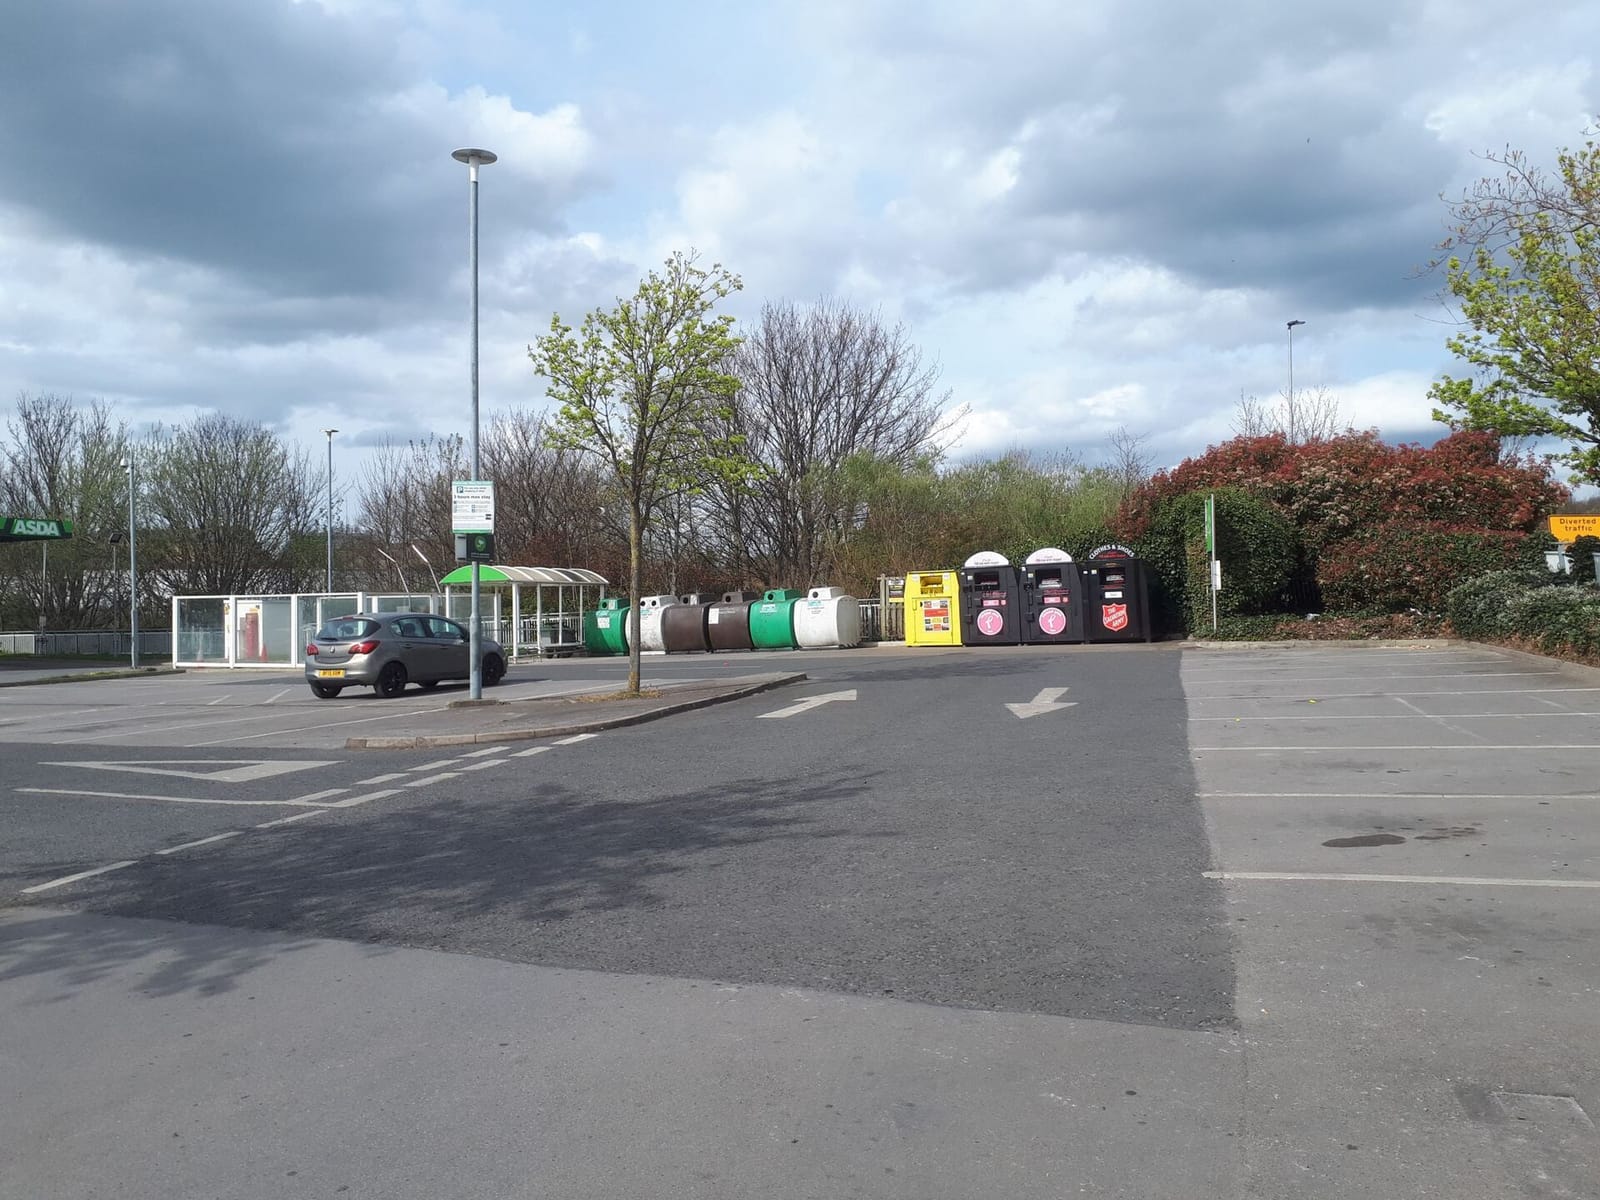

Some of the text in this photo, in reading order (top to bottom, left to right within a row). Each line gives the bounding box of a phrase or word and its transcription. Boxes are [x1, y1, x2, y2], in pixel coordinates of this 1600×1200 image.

[13, 519, 60, 536] ASDA
[1089, 544, 1111, 559] CLOTHES
[1117, 544, 1135, 558] SHOES
